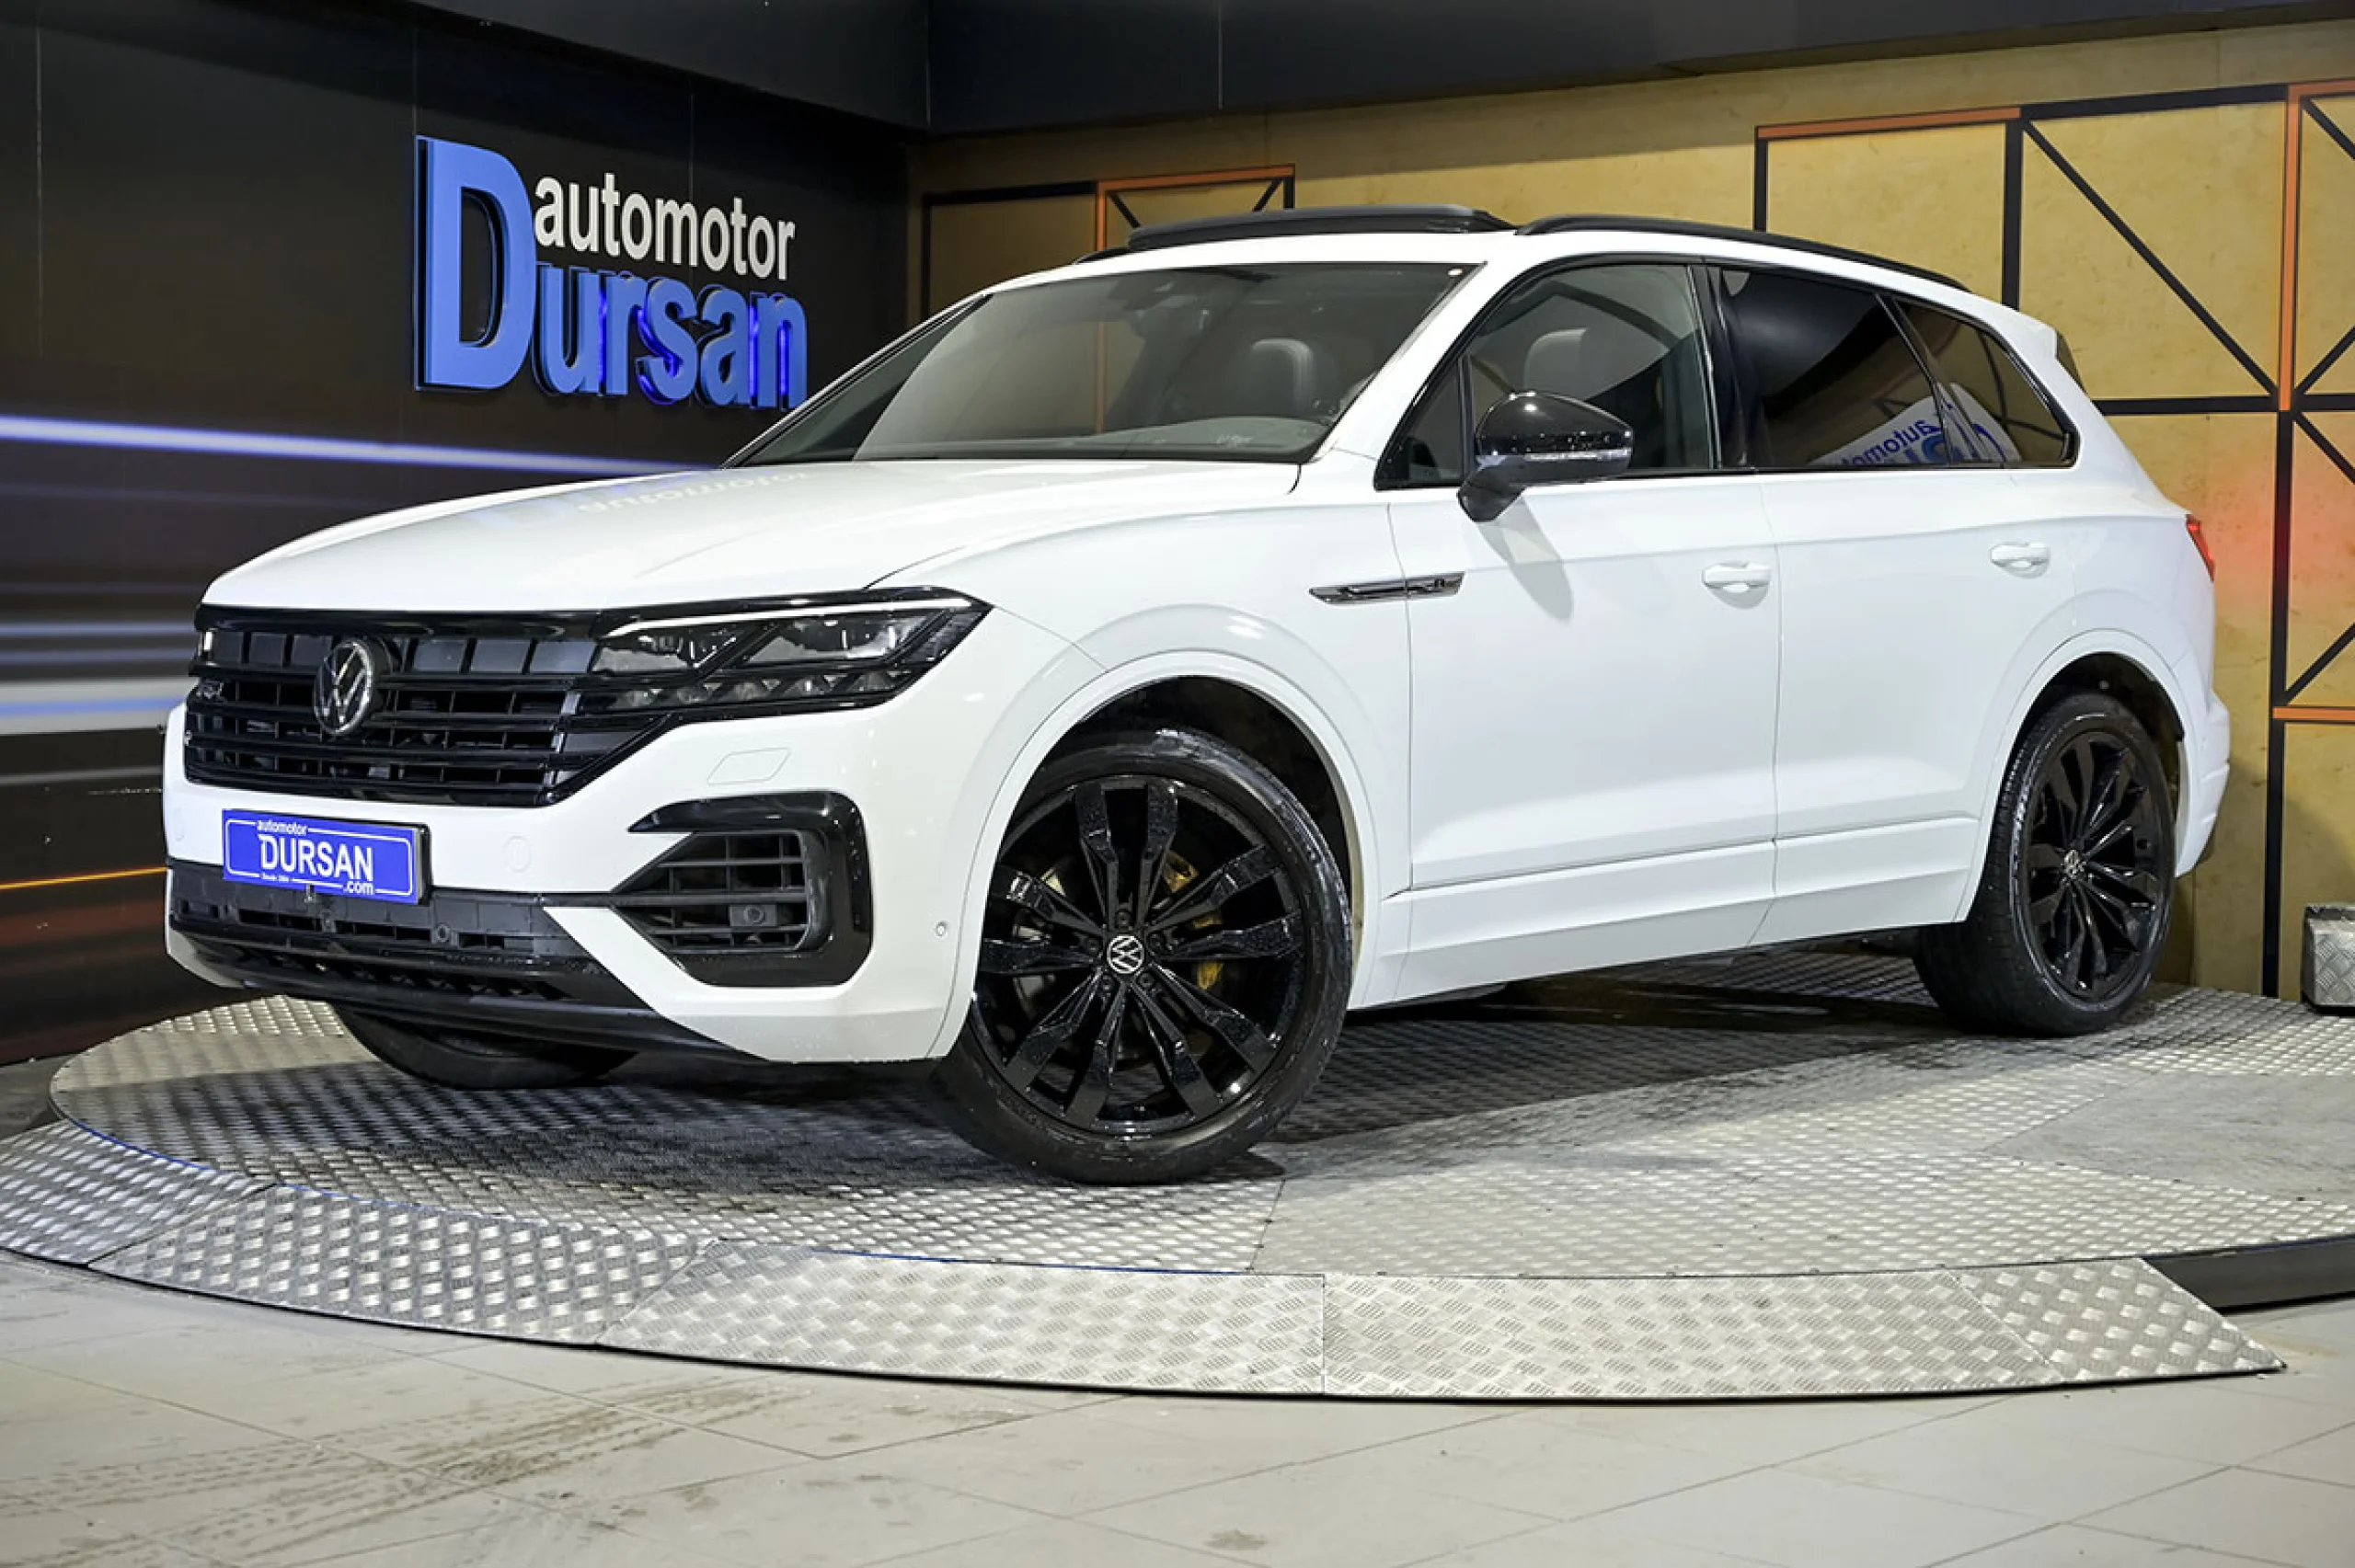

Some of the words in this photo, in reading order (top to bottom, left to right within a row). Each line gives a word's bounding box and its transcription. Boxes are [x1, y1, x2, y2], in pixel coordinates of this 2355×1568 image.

[534, 172, 797, 280] automotor
[415, 134, 808, 411] Dursan
[256, 819, 307, 836] automotor
[257, 833, 374, 882] DURSAN
[342, 880, 374, 896] .com
